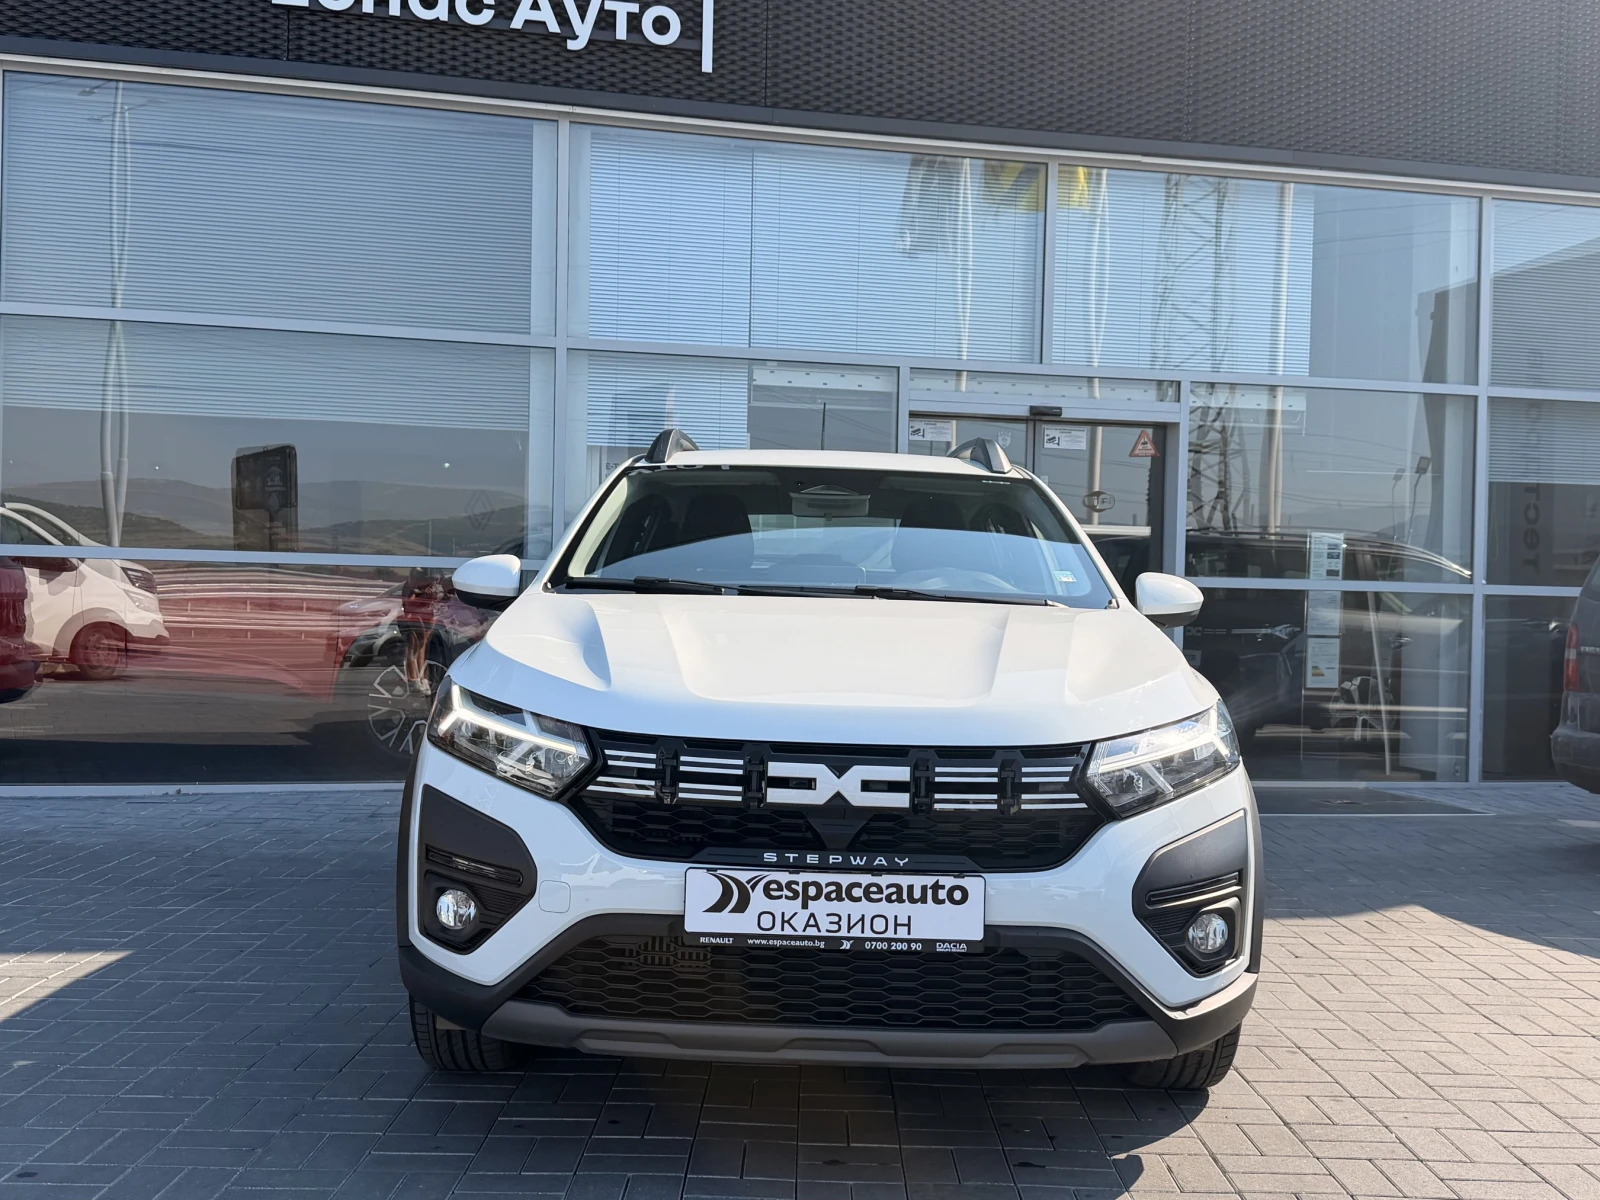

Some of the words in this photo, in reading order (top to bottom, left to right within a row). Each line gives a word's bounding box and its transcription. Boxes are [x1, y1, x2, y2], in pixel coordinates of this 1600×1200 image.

[510, 0, 681, 50] Ауто
[763, 853, 909, 866] STEPWAY
[763, 878, 969, 909] espaceauto
[757, 910, 912, 935] ОКАЗИОН
[700, 936, 734, 944] RENAULT
[747, 938, 825, 948] www.espaceauto.bg
[865, 941, 888, 949] 0700
[890, 942, 908, 950] 200
